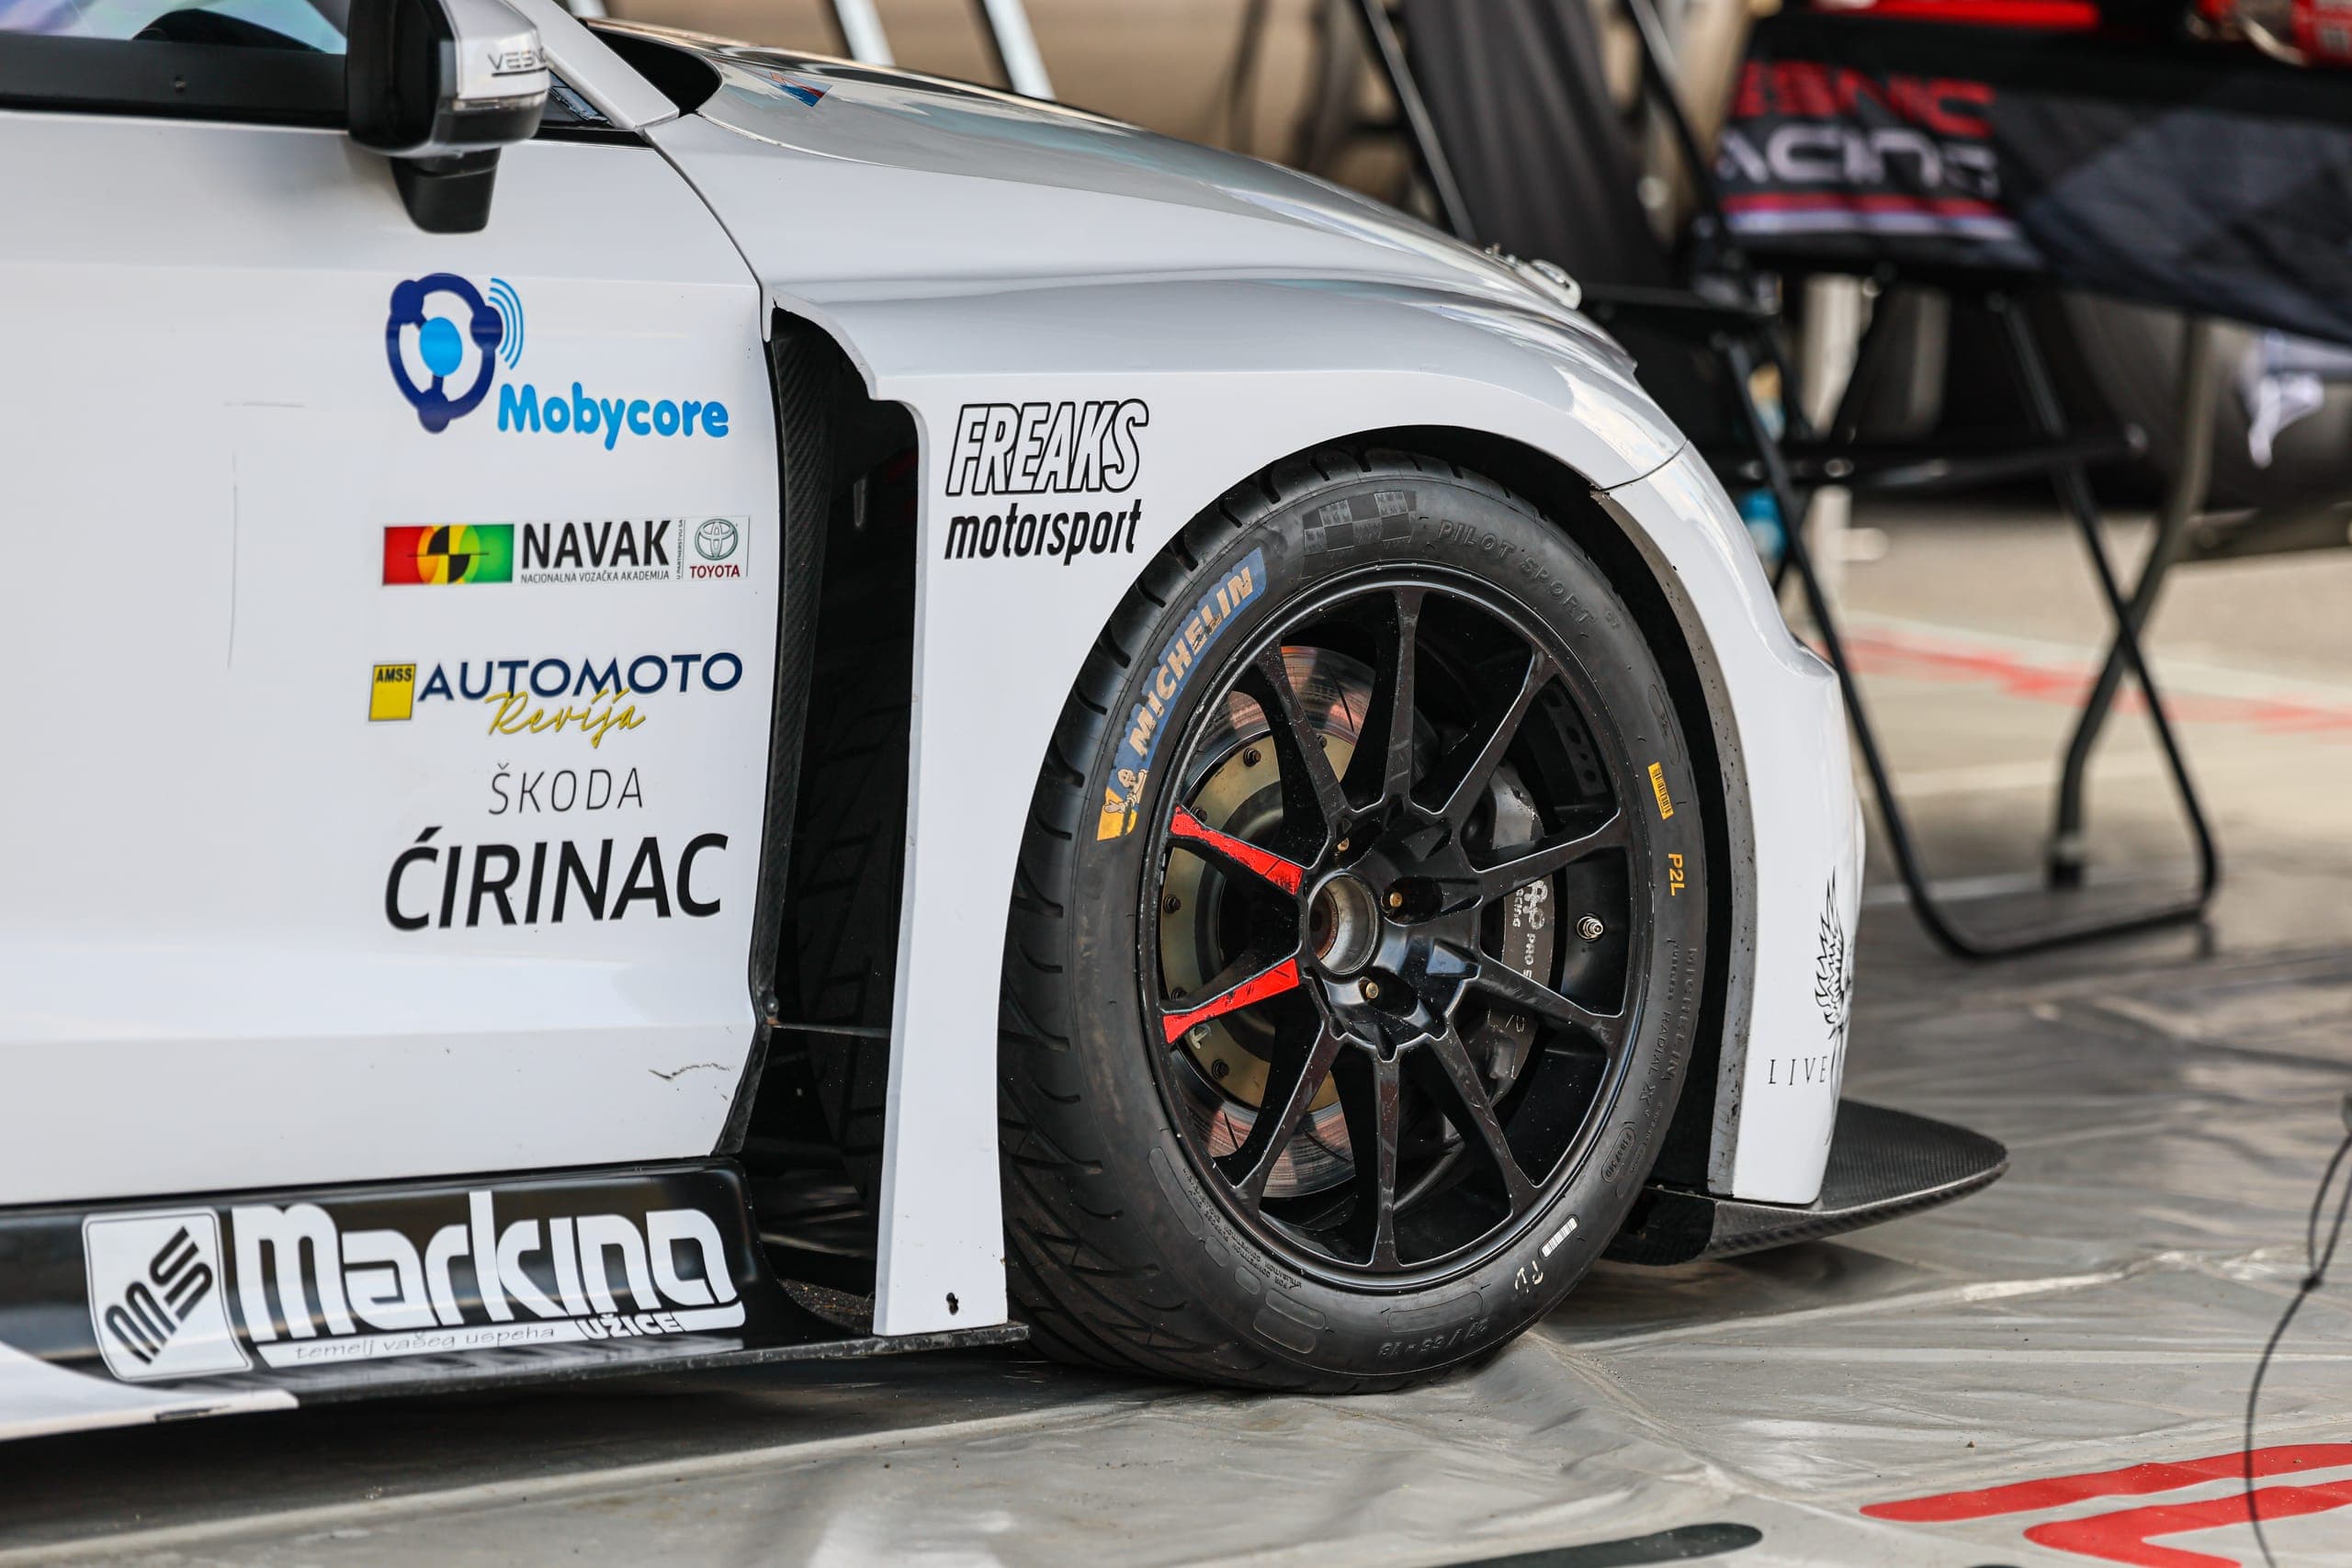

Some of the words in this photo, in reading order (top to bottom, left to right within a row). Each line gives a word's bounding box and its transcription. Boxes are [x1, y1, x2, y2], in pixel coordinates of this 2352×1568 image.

[498, 381, 729, 451] Mobycore
[945, 398, 1149, 497] FREAKS
[522, 519, 672, 570] NAVAK
[944, 499, 1142, 566] motorsport
[520, 570, 577, 584] NACIONALNA
[579, 569, 619, 582] VOZAČKA
[620, 570, 670, 581] AKADEMIJA
[689, 564, 741, 579] TOYOTA
[1437, 519, 1518, 559] PILOT
[1519, 556, 1596, 626] SPORT
[375, 667, 413, 683] AMSS
[418, 651, 743, 702] AUTOMOTO
[1128, 566, 1254, 758] MICHELIN
[485, 686, 646, 749] Revija
[488, 762, 644, 816] ŠKODA
[384, 826, 729, 932] ĆIRINAC
[1668, 852, 1686, 897] P2L
[1647, 1010, 1671, 1075] RADIAL
[1768, 1055, 1828, 1086] LIVE
[296, 1338, 374, 1360] temelj
[383, 1330, 455, 1352] vašeg
[465, 1325, 555, 1348] uspeha
[575, 1311, 685, 1340] UŽICE
